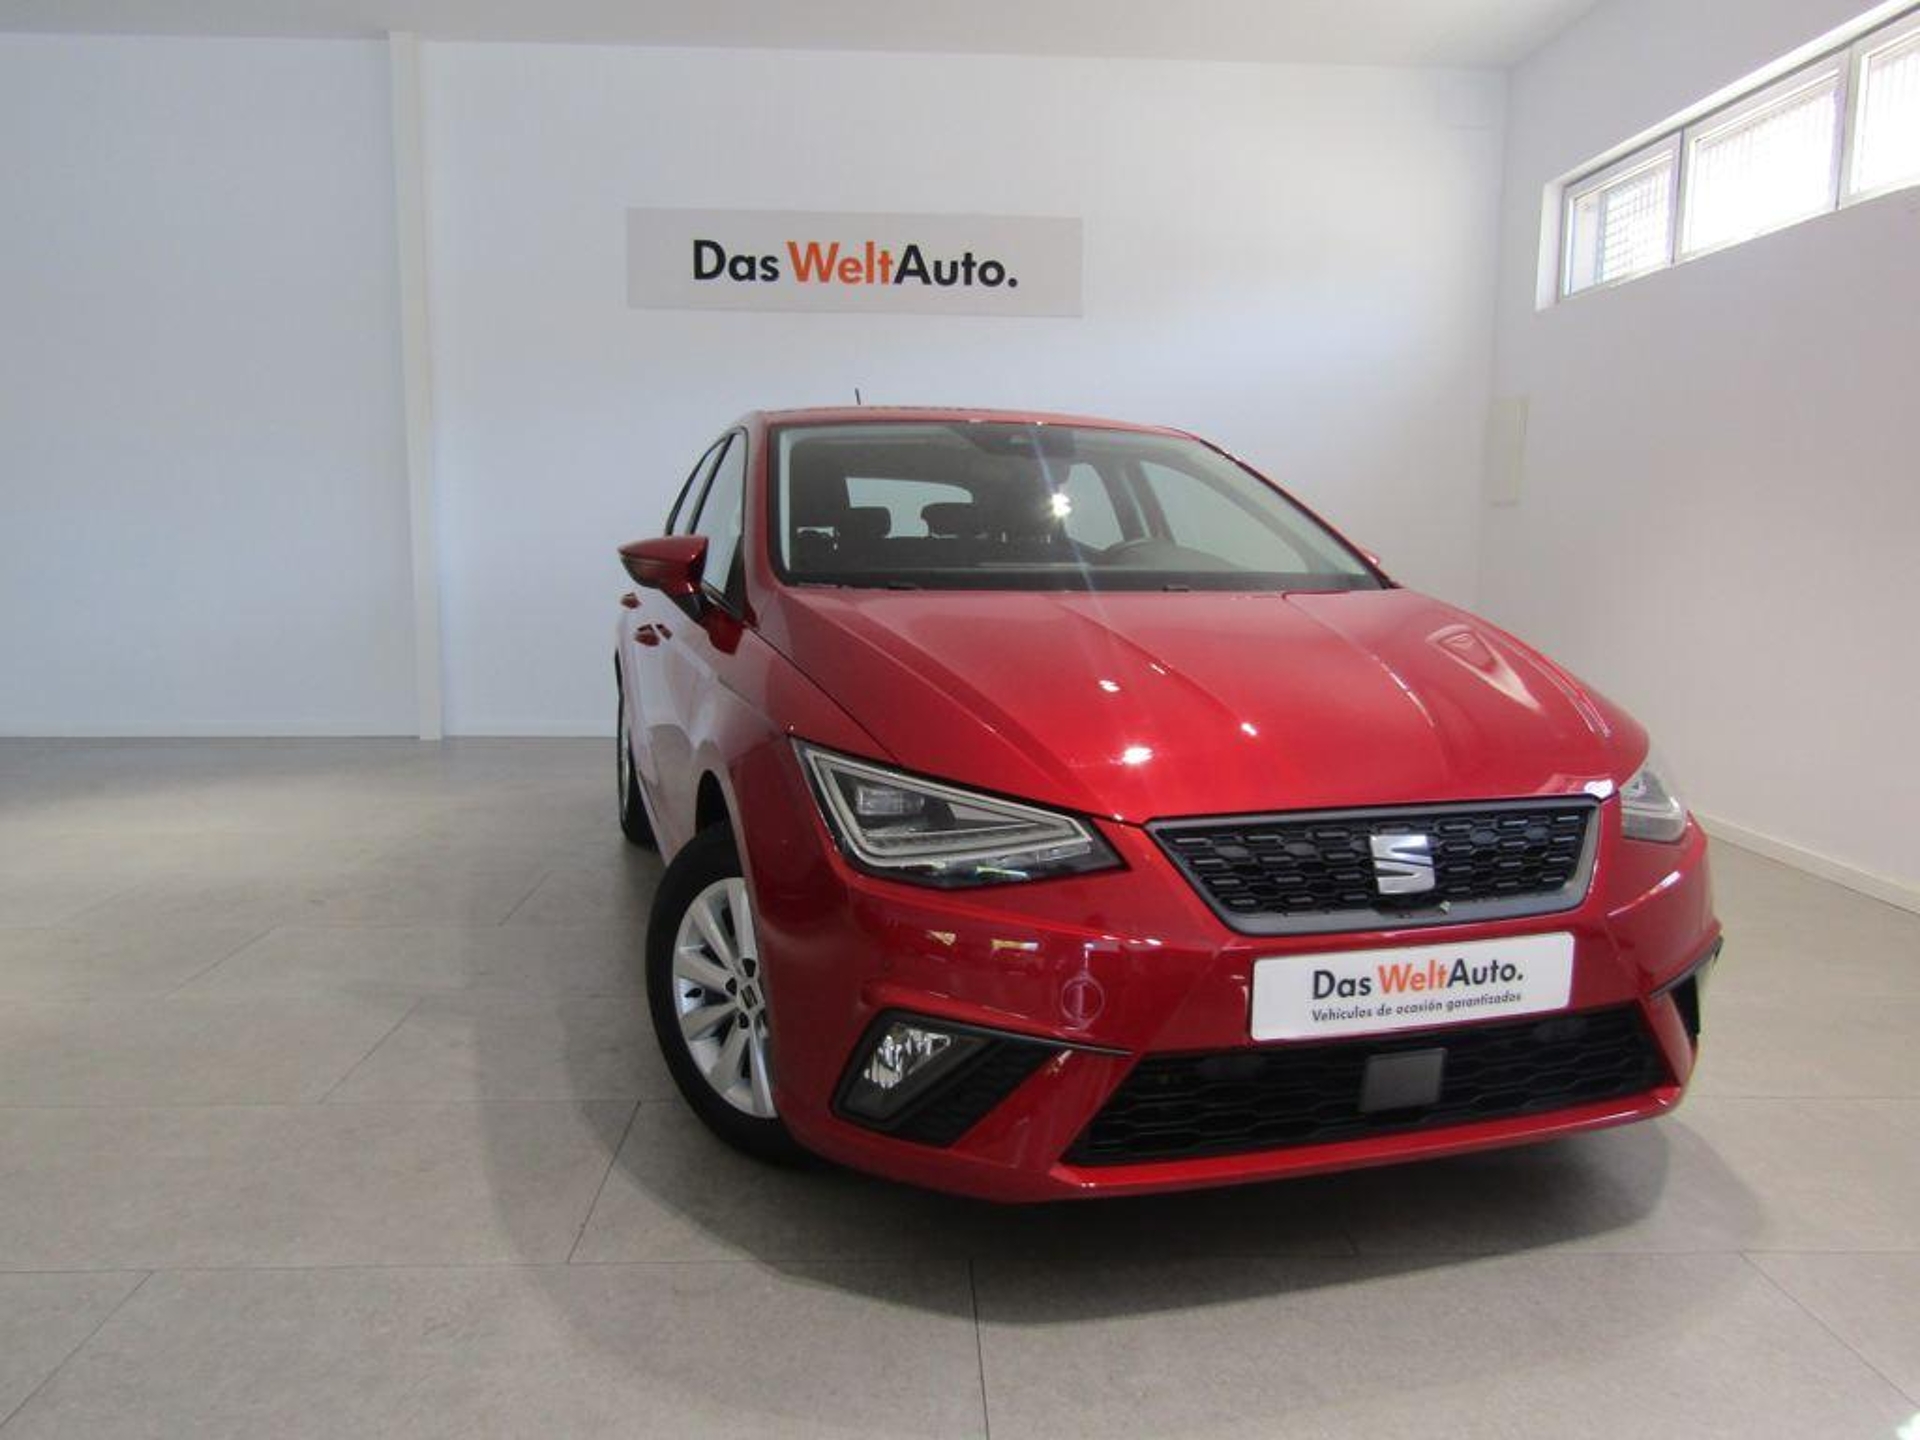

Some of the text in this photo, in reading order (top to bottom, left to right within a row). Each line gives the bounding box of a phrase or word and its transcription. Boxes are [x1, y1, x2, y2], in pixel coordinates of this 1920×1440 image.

[692, 238, 1019, 289] Das WeltAuto.
[1312, 957, 1524, 1001] Das WeltAuto.
[1376, 1005, 1392, 1017] de
[1396, 1000, 1443, 1015] ocasión
[1446, 991, 1522, 1012] garantizados
